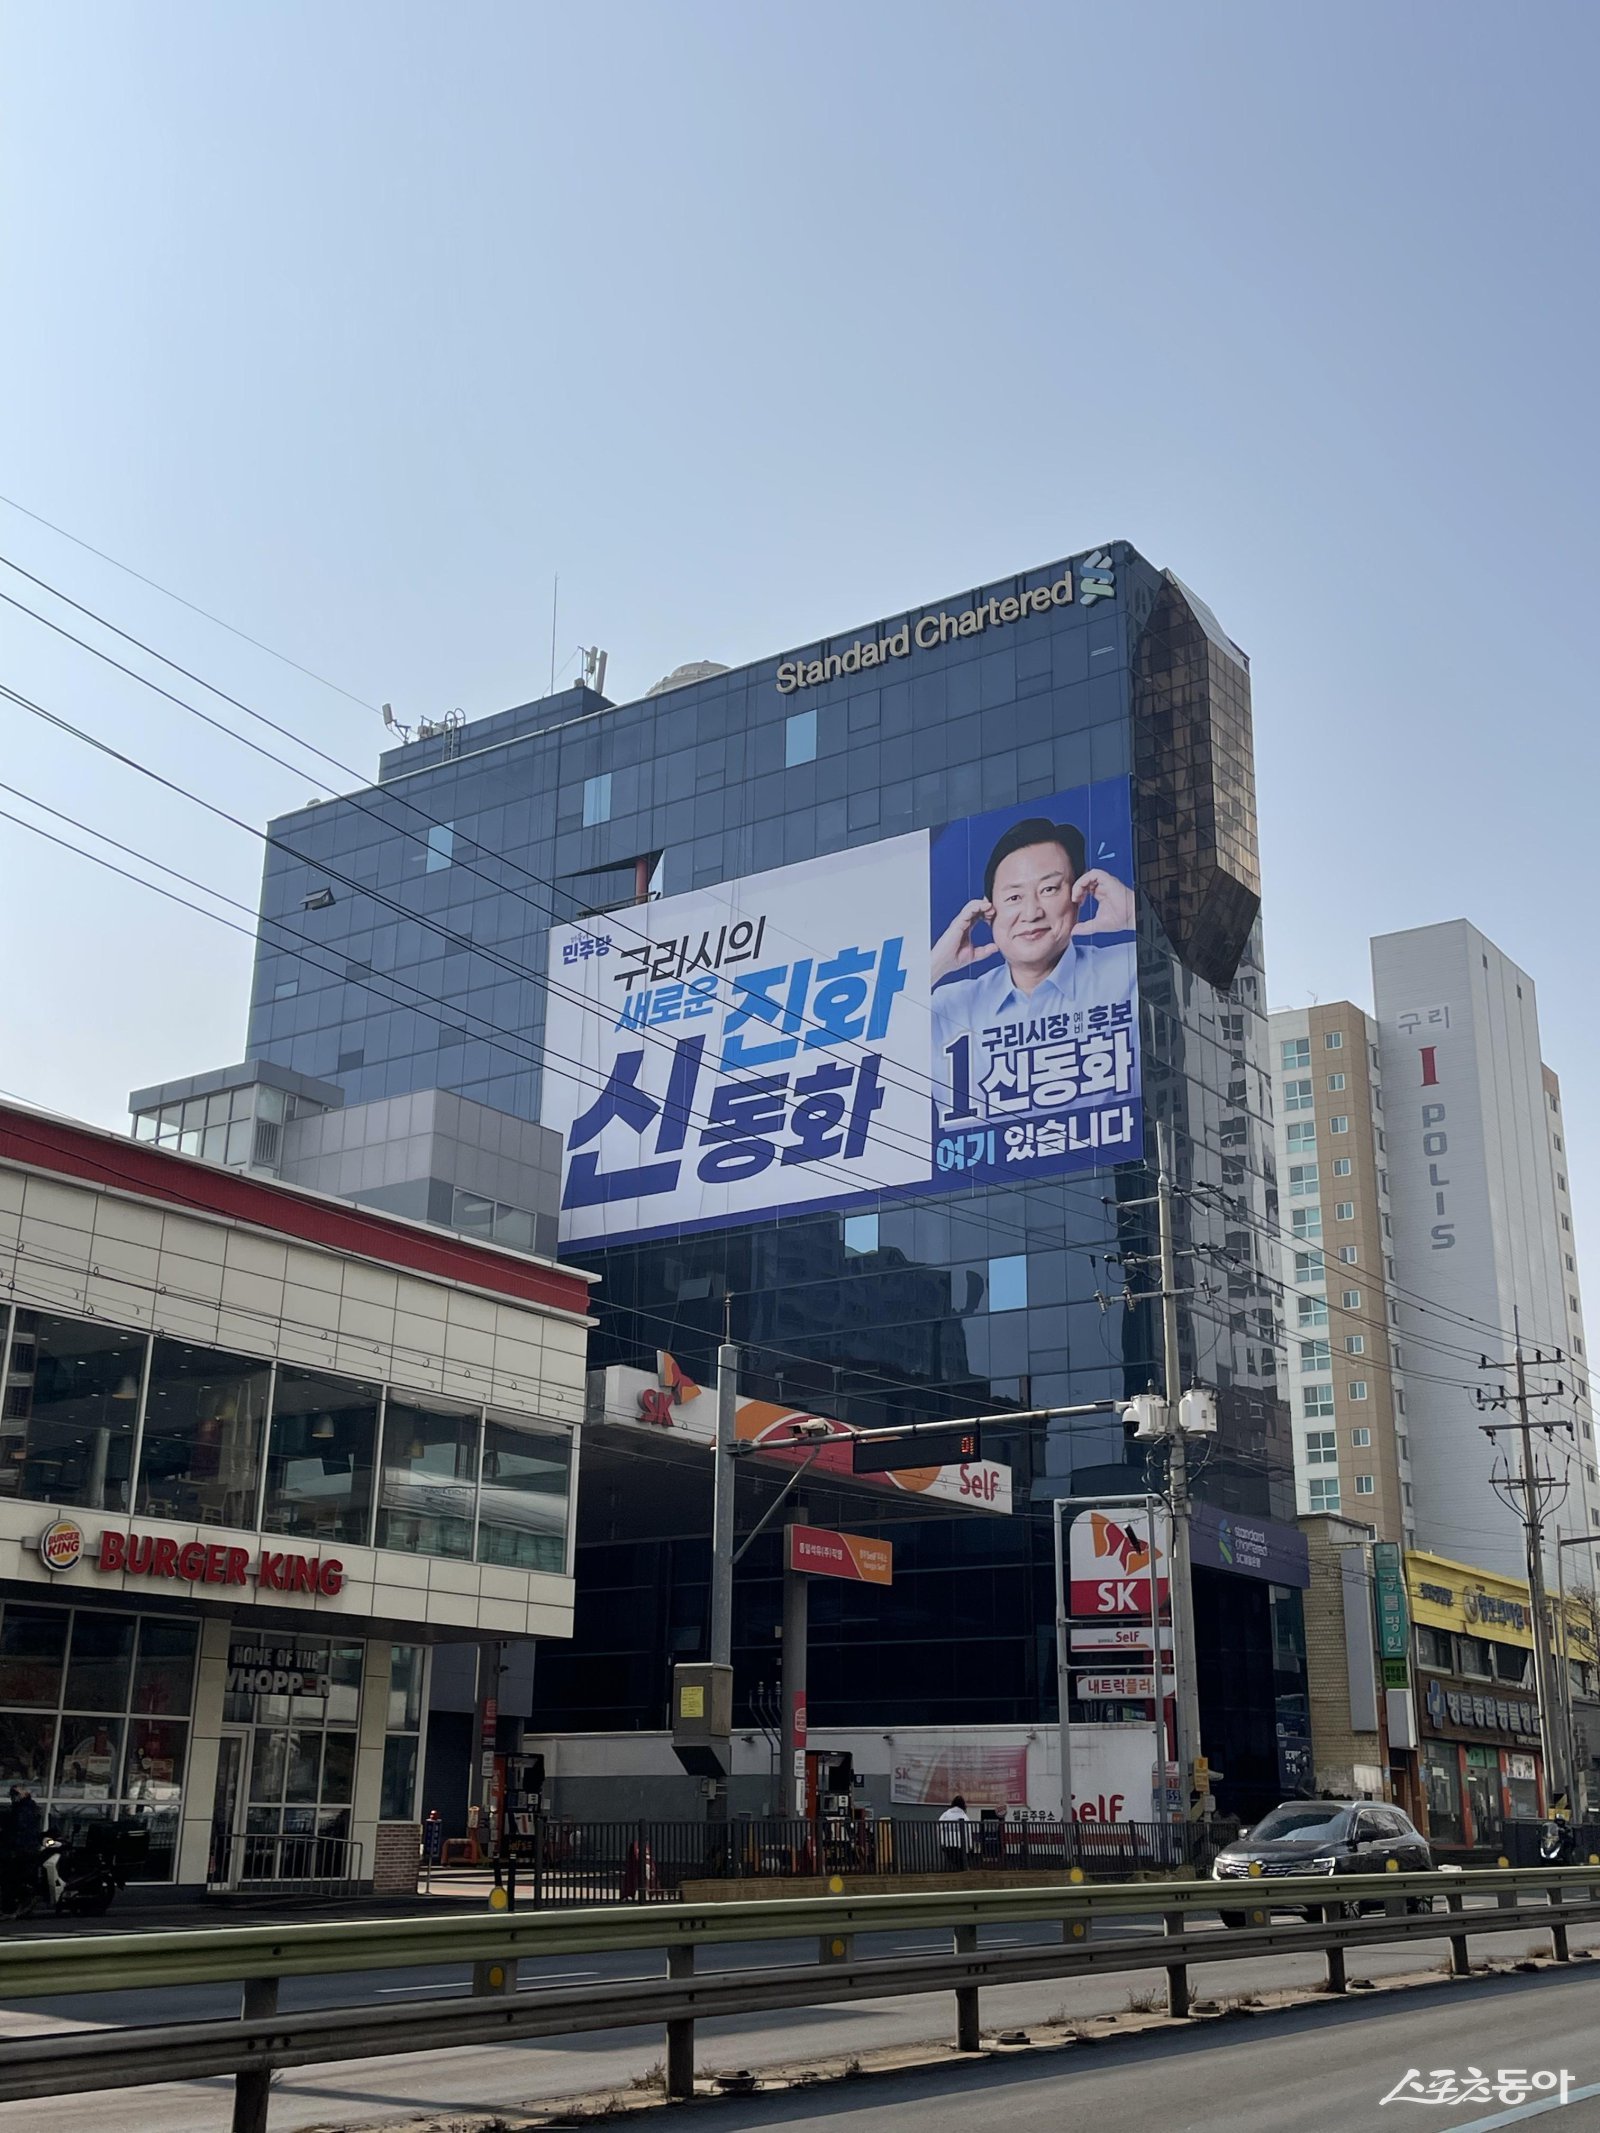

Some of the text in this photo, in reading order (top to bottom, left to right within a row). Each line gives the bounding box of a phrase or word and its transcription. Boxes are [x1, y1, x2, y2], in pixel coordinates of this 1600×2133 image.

[775, 570, 1073, 695] Standard Chartered
[562, 934, 613, 965] 민주당
[613, 915, 767, 992] 구리시의
[614, 975, 719, 1034] 새로운
[719, 936, 906, 1071] 진화
[1397, 1005, 1452, 1035] 구리
[981, 1013, 1070, 1052] 구리시장
[1087, 1000, 1133, 1032] 후보
[942, 1031, 979, 1123] 1
[980, 1030, 1133, 1116] 신동화
[1417, 1045, 1440, 1087] I
[561, 1033, 883, 1210] 신동화
[936, 1106, 1134, 1172] 여기 있습니다
[1421, 1102, 1456, 1250] POLIS
[637, 1388, 675, 1427] SK
[959, 1462, 1000, 1502] Self
[47, 1541, 80, 1557] KING
[48, 1531, 80, 1545] BURGER
[98, 1530, 345, 1597] BURGER KING
[1096, 1581, 1140, 1612] SK
[233, 1646, 321, 1669] HOME OF THE
[1115, 1631, 1141, 1643] Self
[1087, 1678, 1156, 1695] 내트럭플러
[1012, 1809, 1056, 1822] 셀프주유소
